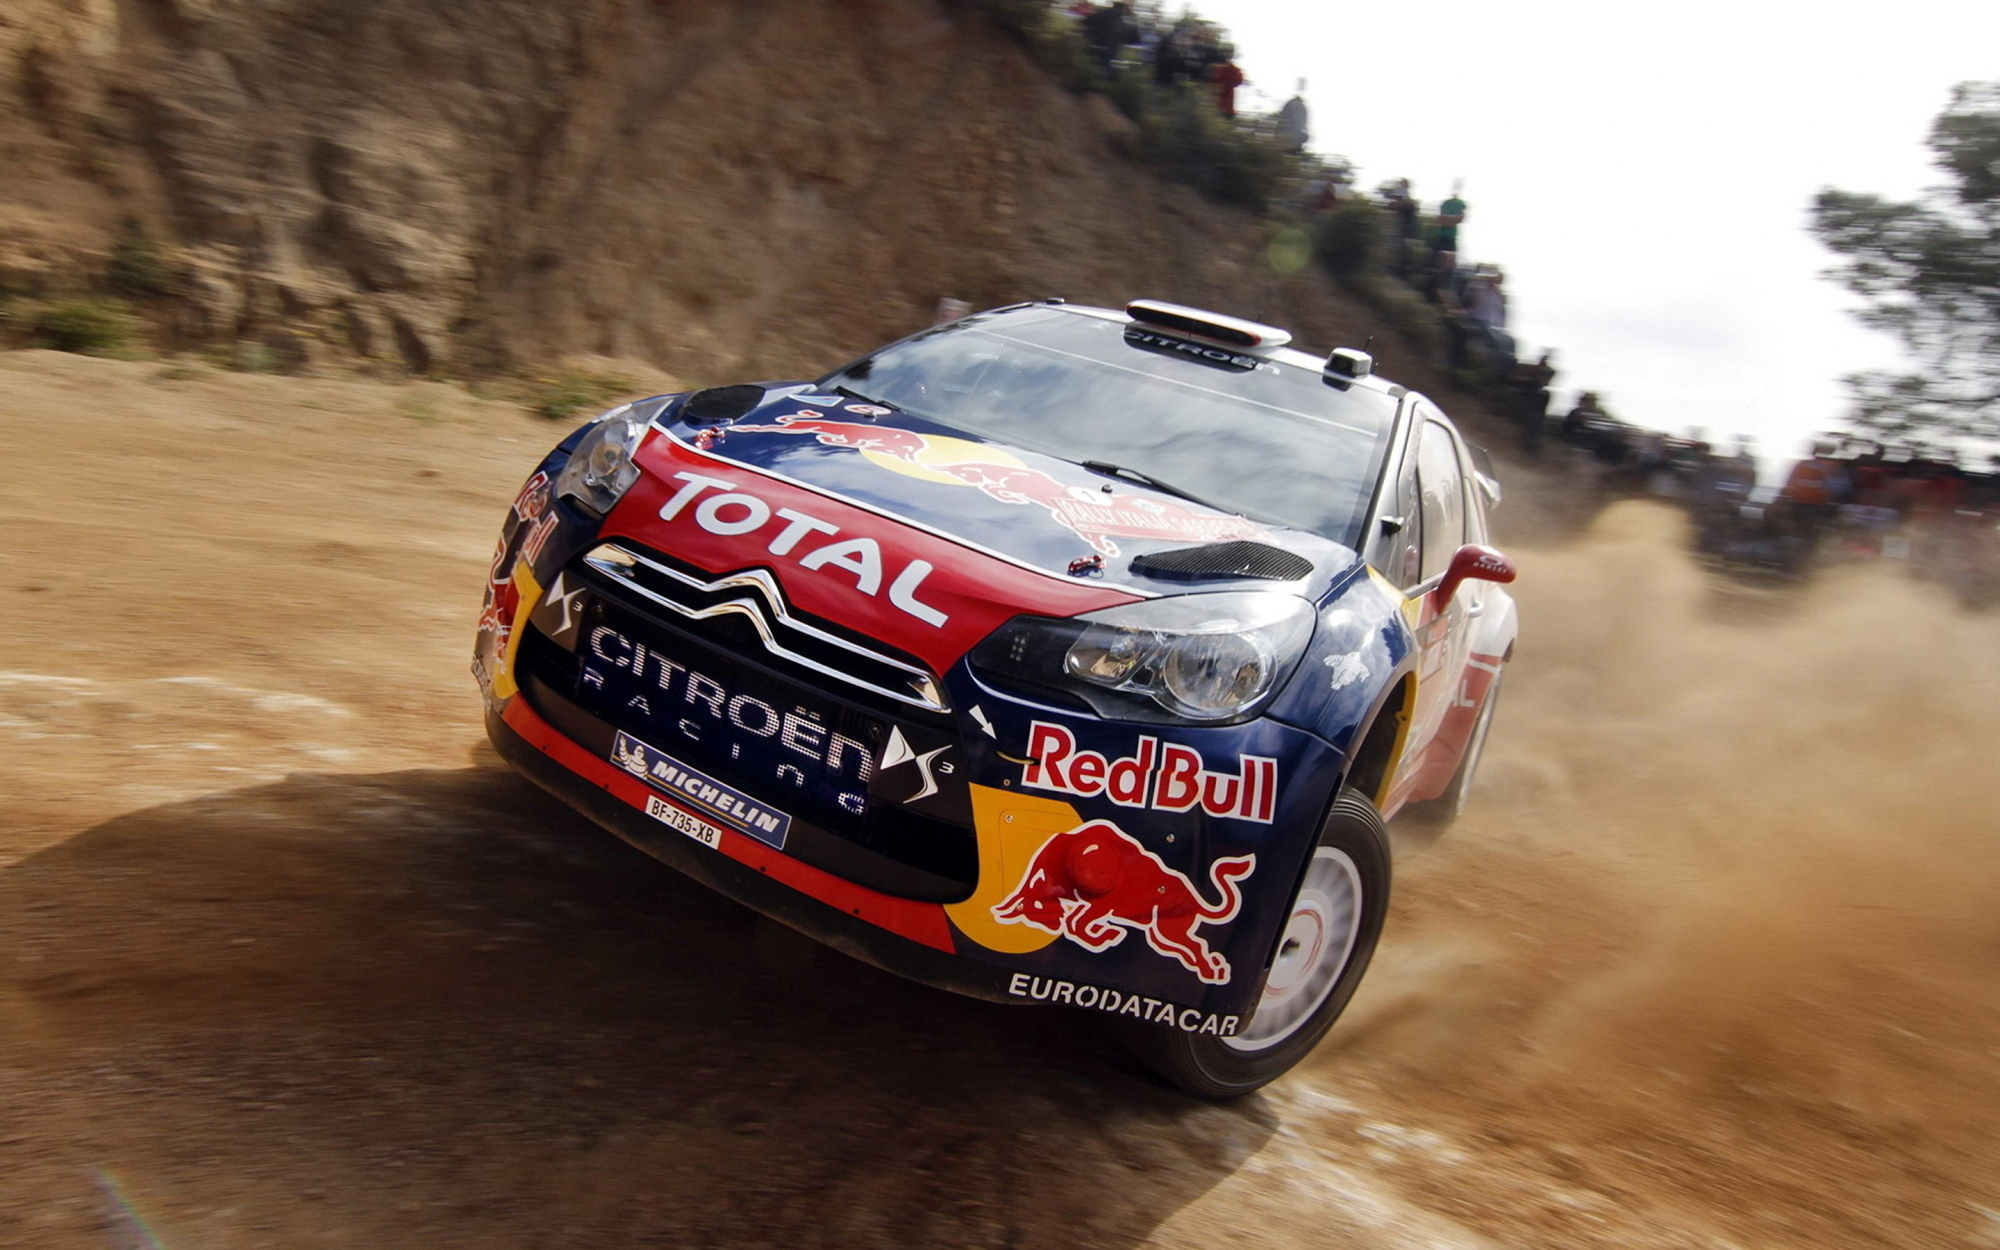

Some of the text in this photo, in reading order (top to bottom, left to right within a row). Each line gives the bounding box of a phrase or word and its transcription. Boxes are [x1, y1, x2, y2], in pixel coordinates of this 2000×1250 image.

[1059, 499, 1118, 526] RALLY
[658, 470, 950, 629] TOTAL
[650, 799, 714, 845] BF-735-XB
[652, 759, 780, 834] MICHELIN
[1009, 973, 1240, 1037] EURODATACAR
